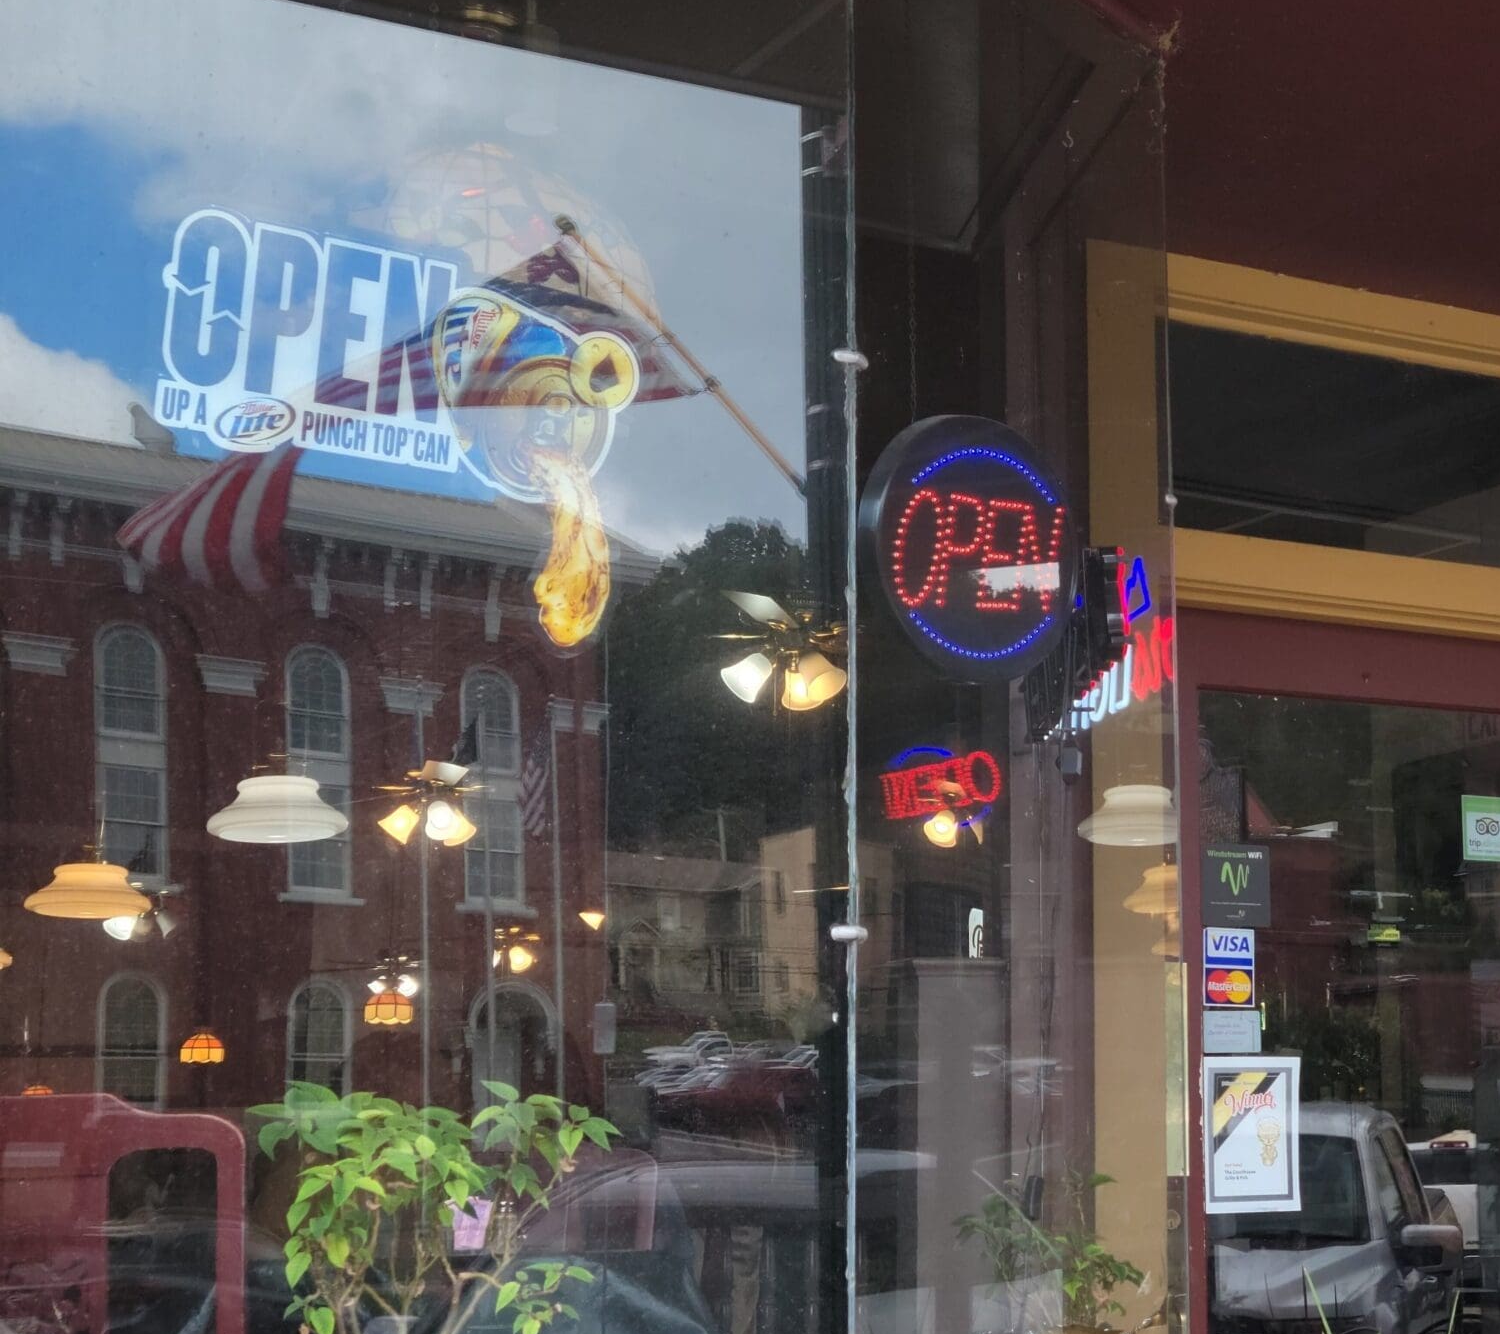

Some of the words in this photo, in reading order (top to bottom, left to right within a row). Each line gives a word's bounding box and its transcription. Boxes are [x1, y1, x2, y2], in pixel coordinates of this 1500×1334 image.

[163, 208, 458, 416] OPEN
[161, 386, 190, 422] UP
[193, 392, 206, 425] A
[301, 410, 367, 450] PUNCH
[412, 427, 451, 466] CAN
[892, 488, 1067, 612] OPEN
[1247, 851, 1263, 860] WiFi
[1211, 934, 1250, 953] VISA
[1207, 980, 1250, 992] MasterCard
[1223, 1089, 1277, 1115] Winner
